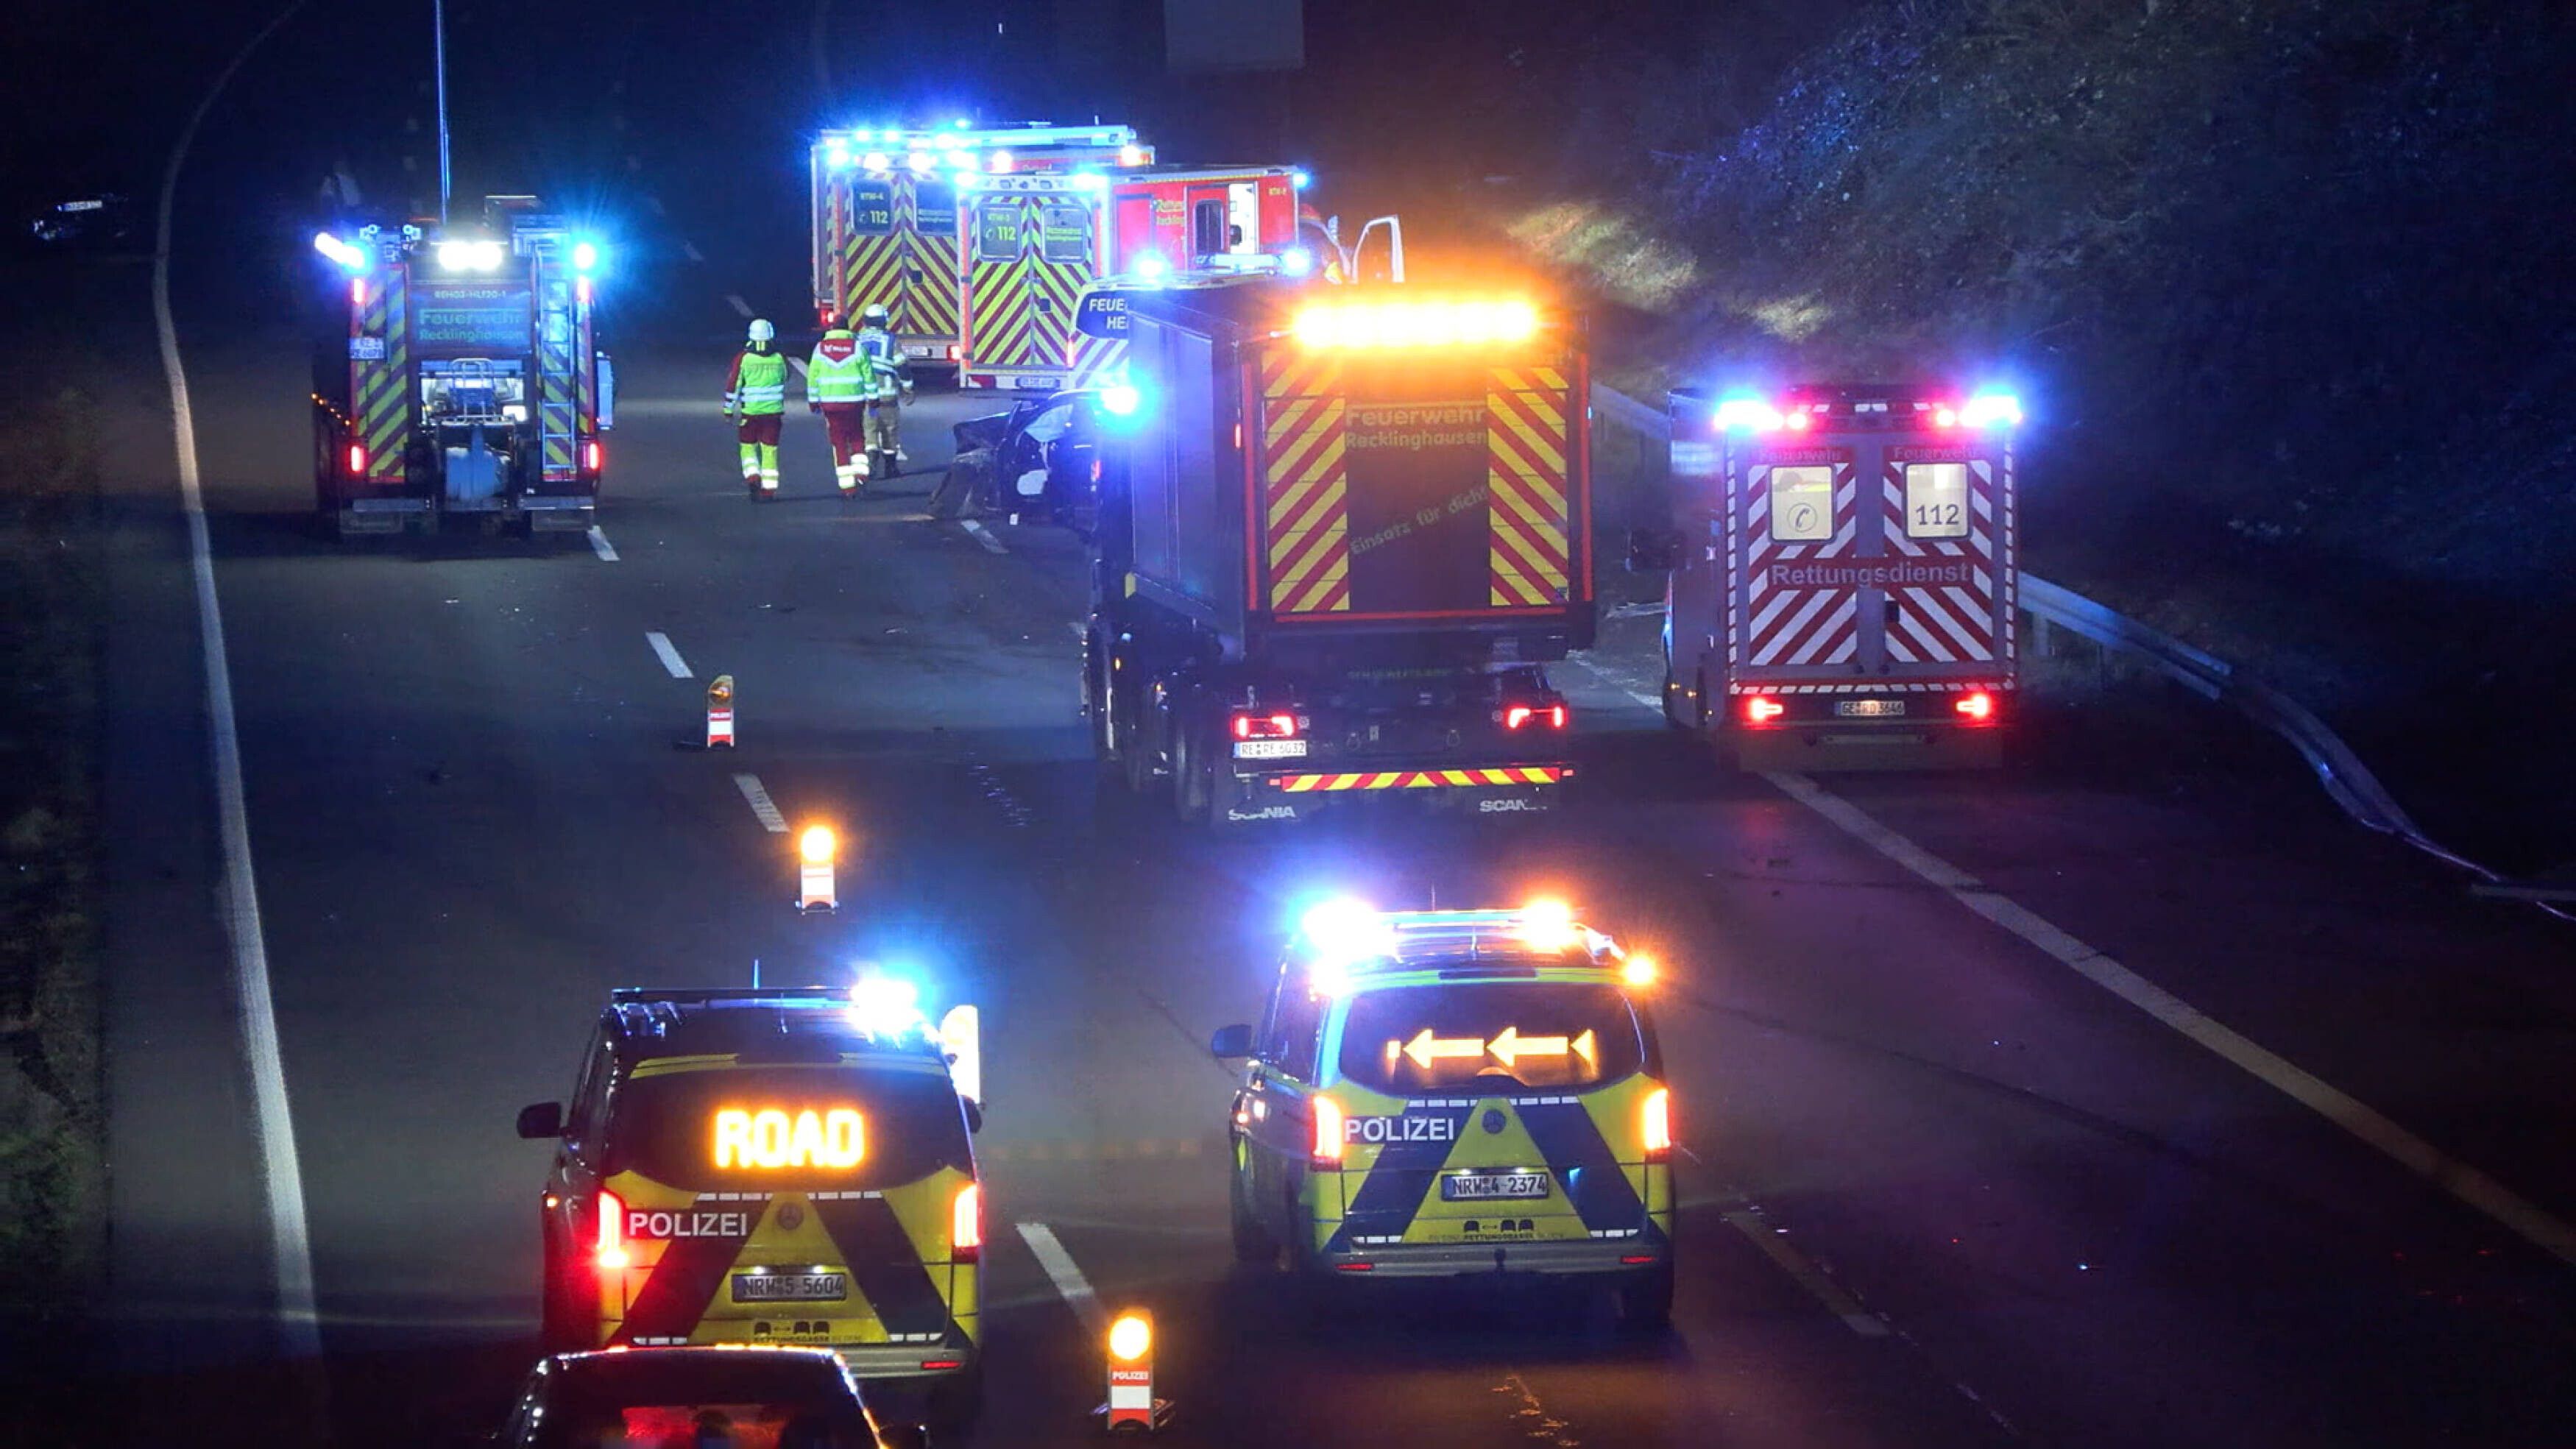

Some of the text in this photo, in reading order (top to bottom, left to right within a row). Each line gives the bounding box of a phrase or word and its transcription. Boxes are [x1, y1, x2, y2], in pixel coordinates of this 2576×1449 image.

[870, 210, 888, 224] 112
[997, 226, 1016, 241] 112
[1089, 298, 1125, 312] FEUE
[1107, 316, 1128, 330] HE
[1347, 406, 1485, 426] Feuerwehr
[1345, 427, 1487, 450] Recklinghausen
[1915, 504, 1960, 525] 112
[1772, 561, 1970, 587] Rettungsdienst
[1479, 799, 1547, 812] SCAN
[715, 1109, 865, 1169] ROAD
[1345, 1116, 1455, 1142] POLIZEI
[1454, 1178, 1482, 1195] NRW
[629, 1213, 748, 1237] POLIZEI
